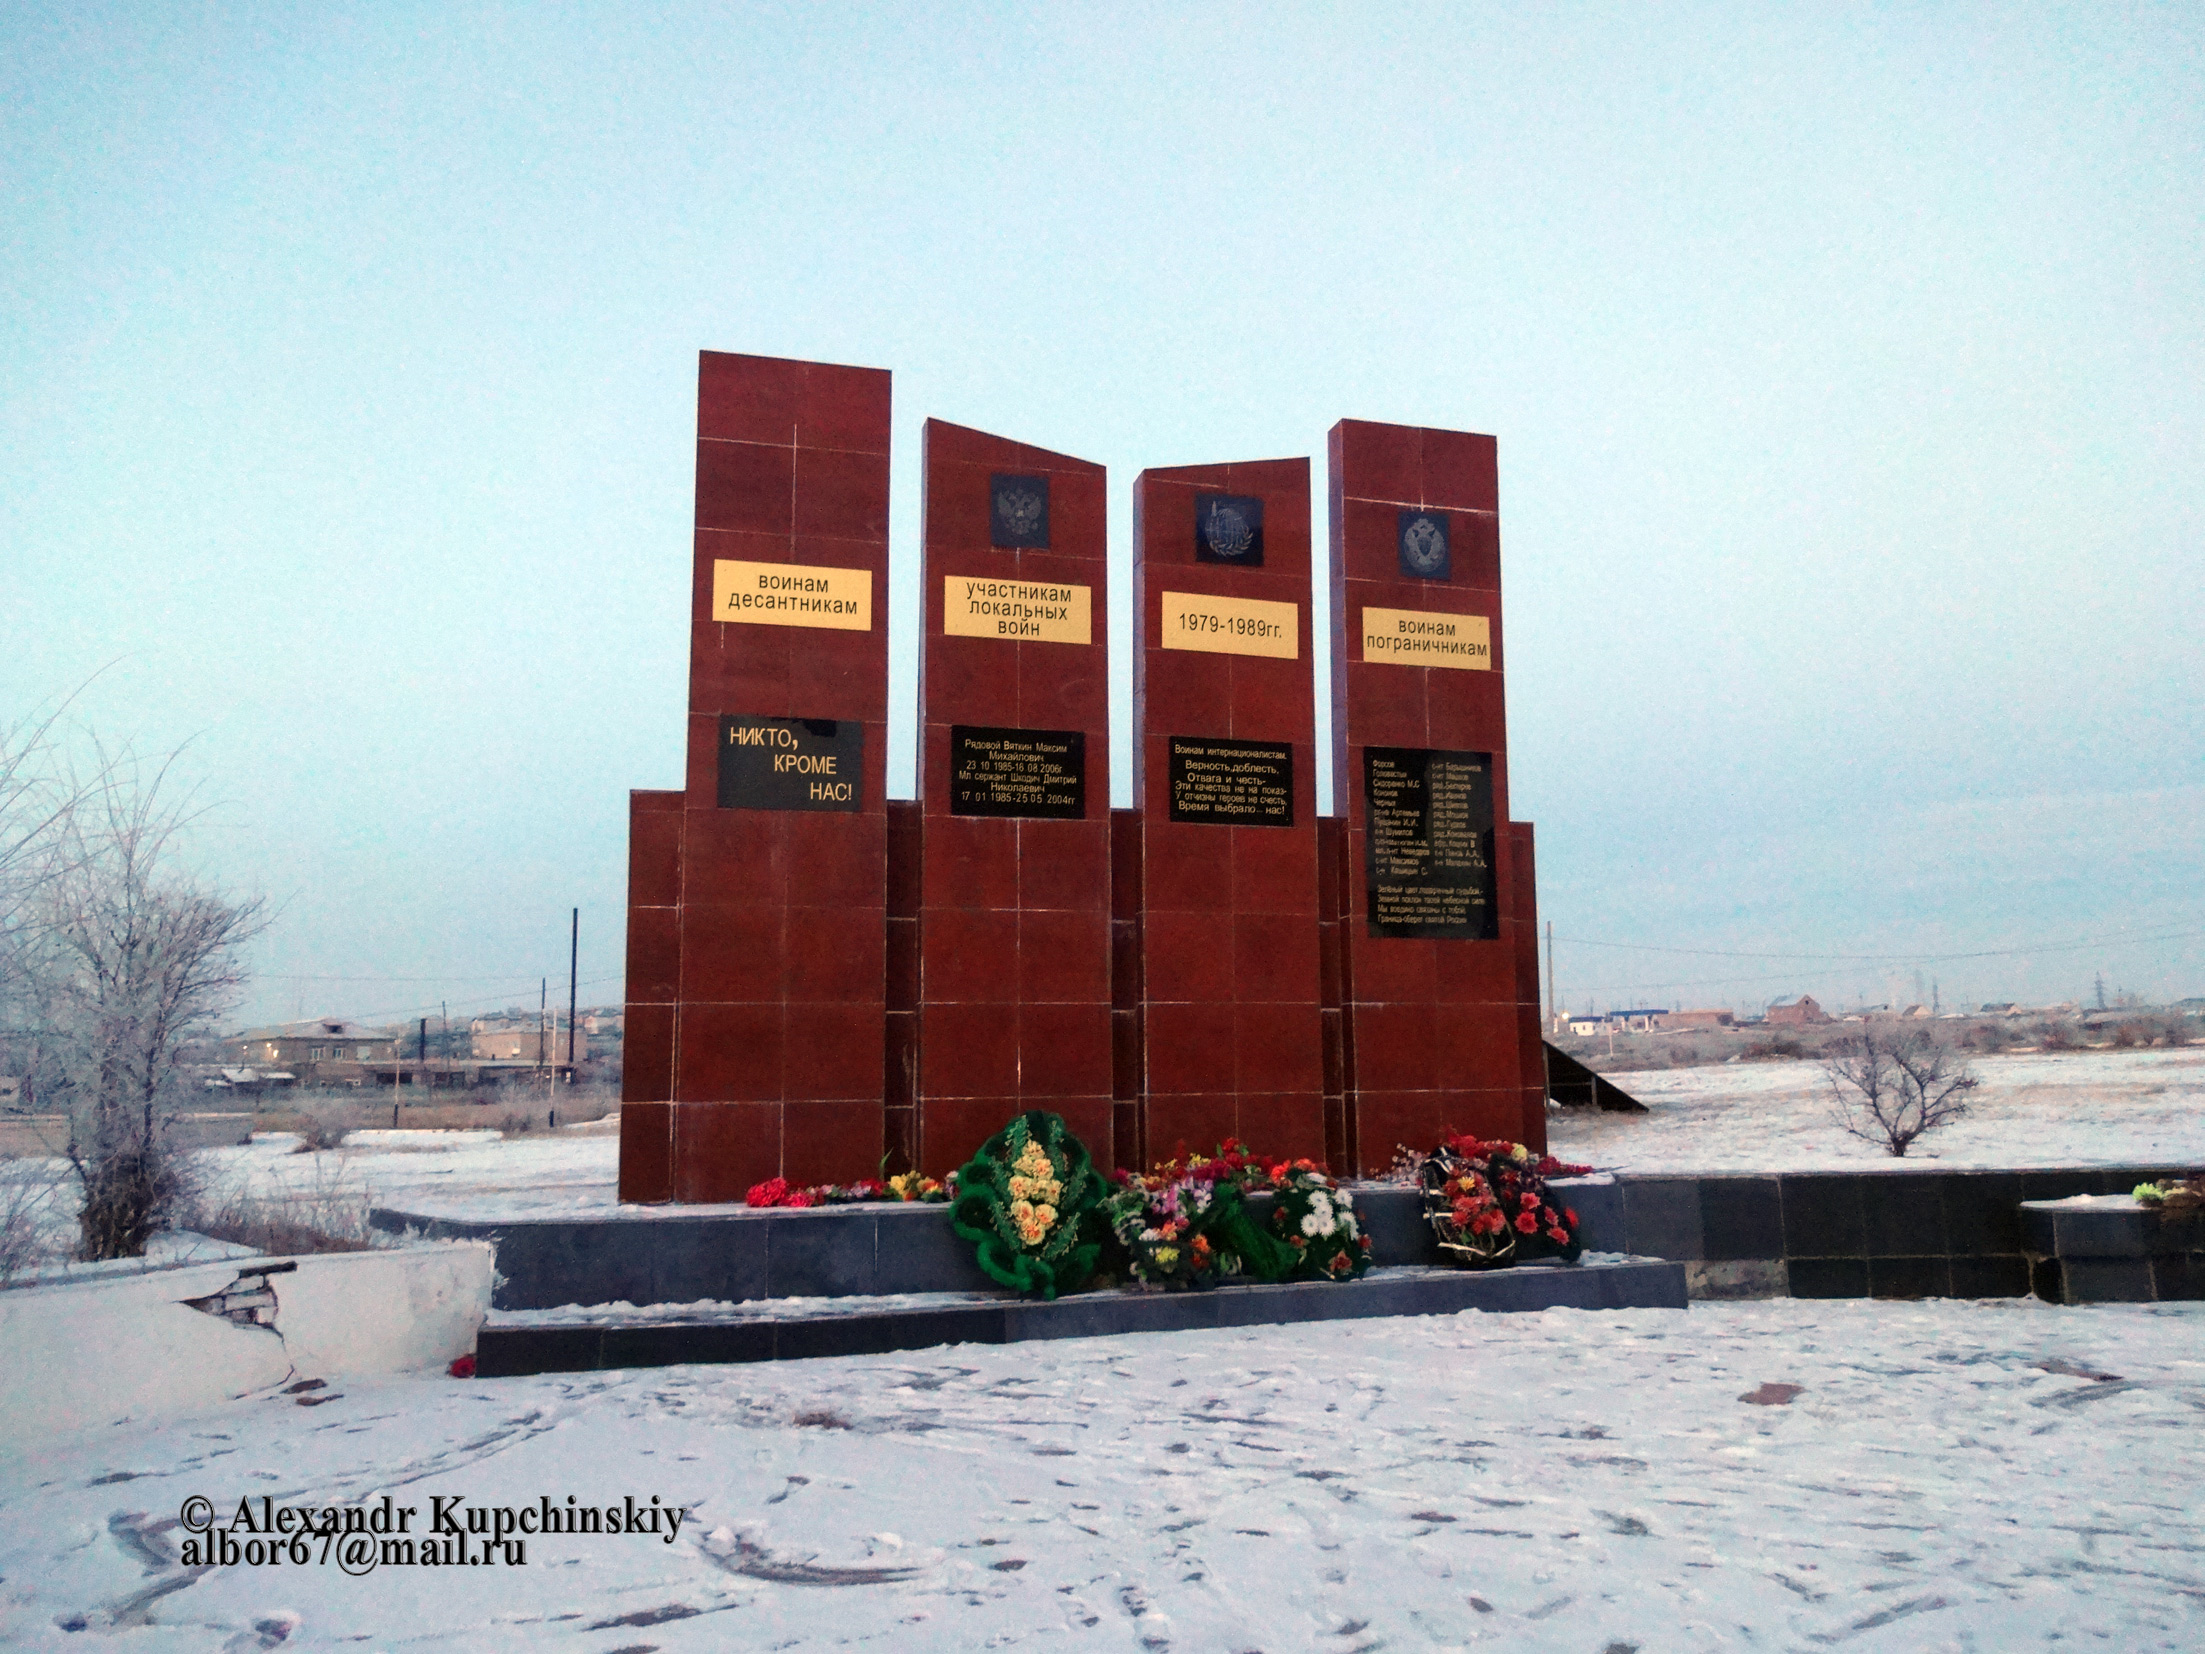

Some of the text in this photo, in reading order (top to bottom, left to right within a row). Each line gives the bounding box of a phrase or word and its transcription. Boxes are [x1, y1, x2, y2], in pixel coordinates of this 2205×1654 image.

[759, 575, 829, 593] воинам
[966, 582, 1072, 603] участникам
[728, 593, 857, 615] десантникам
[969, 600, 1068, 620] локальных
[998, 618, 1040, 636] войн
[1179, 613, 1282, 638] 1979-1989гг.
[1398, 620, 1456, 636] воинам
[1366, 635, 1487, 656] пограничникам
[730, 726, 799, 751] НИКТО,
[965, 738, 1000, 750] Рядовой
[1036, 743, 1067, 753] Максим
[989, 750, 1044, 762] Михайлович
[1175, 744, 1204, 755] Воинам
[774, 754, 837, 775] КРОМЕ
[974, 773, 1007, 782] сержант
[1043, 774, 1077, 785] Дмитрий
[1187, 772, 1221, 783] Отвага
[810, 782, 852, 801] НАС!
[990, 782, 1045, 792] Николаевич
[1175, 780, 1191, 790] Эти
[1194, 783, 1231, 793] качества
[1234, 785, 1244, 794] не
[1248, 786, 1258, 794] на
[1175, 790, 1181, 800] У
[1247, 795, 1258, 804] не
[1178, 800, 1210, 812] Время
[1265, 806, 1285, 815] нас!
